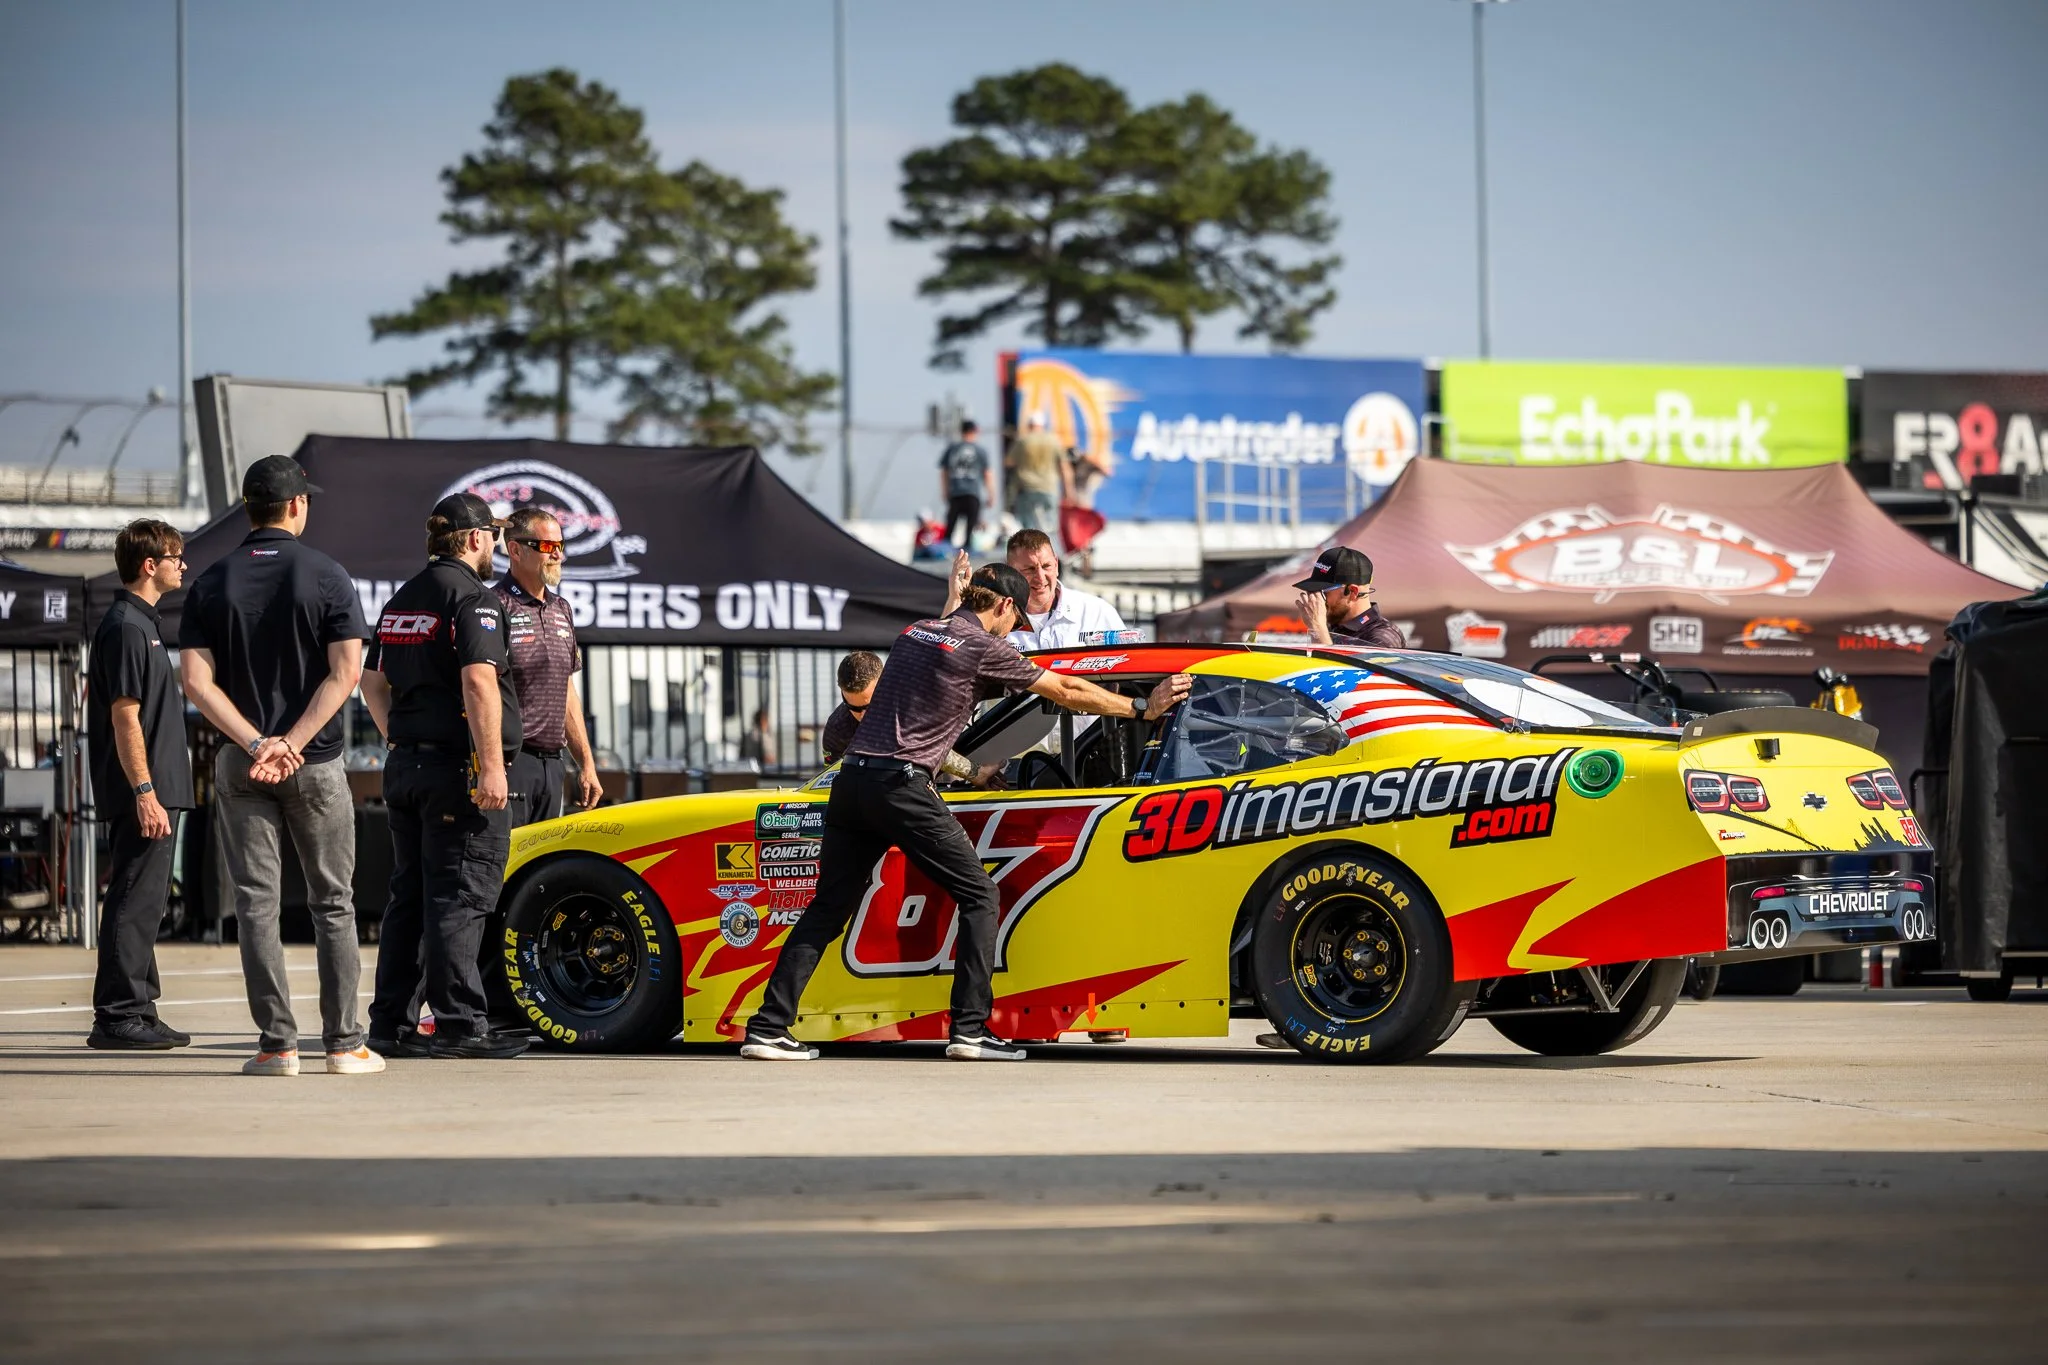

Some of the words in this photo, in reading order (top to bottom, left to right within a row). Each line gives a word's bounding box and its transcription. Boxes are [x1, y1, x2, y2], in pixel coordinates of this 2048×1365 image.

[1130, 411, 1340, 464] Autotrader
[1519, 390, 1772, 464] EchoPark
[1551, 534, 1748, 580] B&L
[558, 580, 702, 630] BERS
[715, 580, 850, 631] ONLY
[377, 614, 438, 634] ECR
[901, 626, 965, 649] imensional
[1126, 749, 1571, 857] 3Dimensional
[763, 812, 801, 829] O'Reilly
[1457, 803, 1551, 842] .com
[761, 841, 821, 859] COMETIC
[717, 871, 754, 879] KENNAMETAL
[763, 866, 814, 877] LINCOLN
[1282, 862, 1411, 911] GOODYEAR
[723, 903, 755, 919] CHAMPION
[1808, 891, 1889, 915] CHEVROLET
[622, 890, 661, 955] EAGLE
[504, 927, 578, 1044] GOODYEAR
[1303, 1030, 1372, 1053] EAGLE
